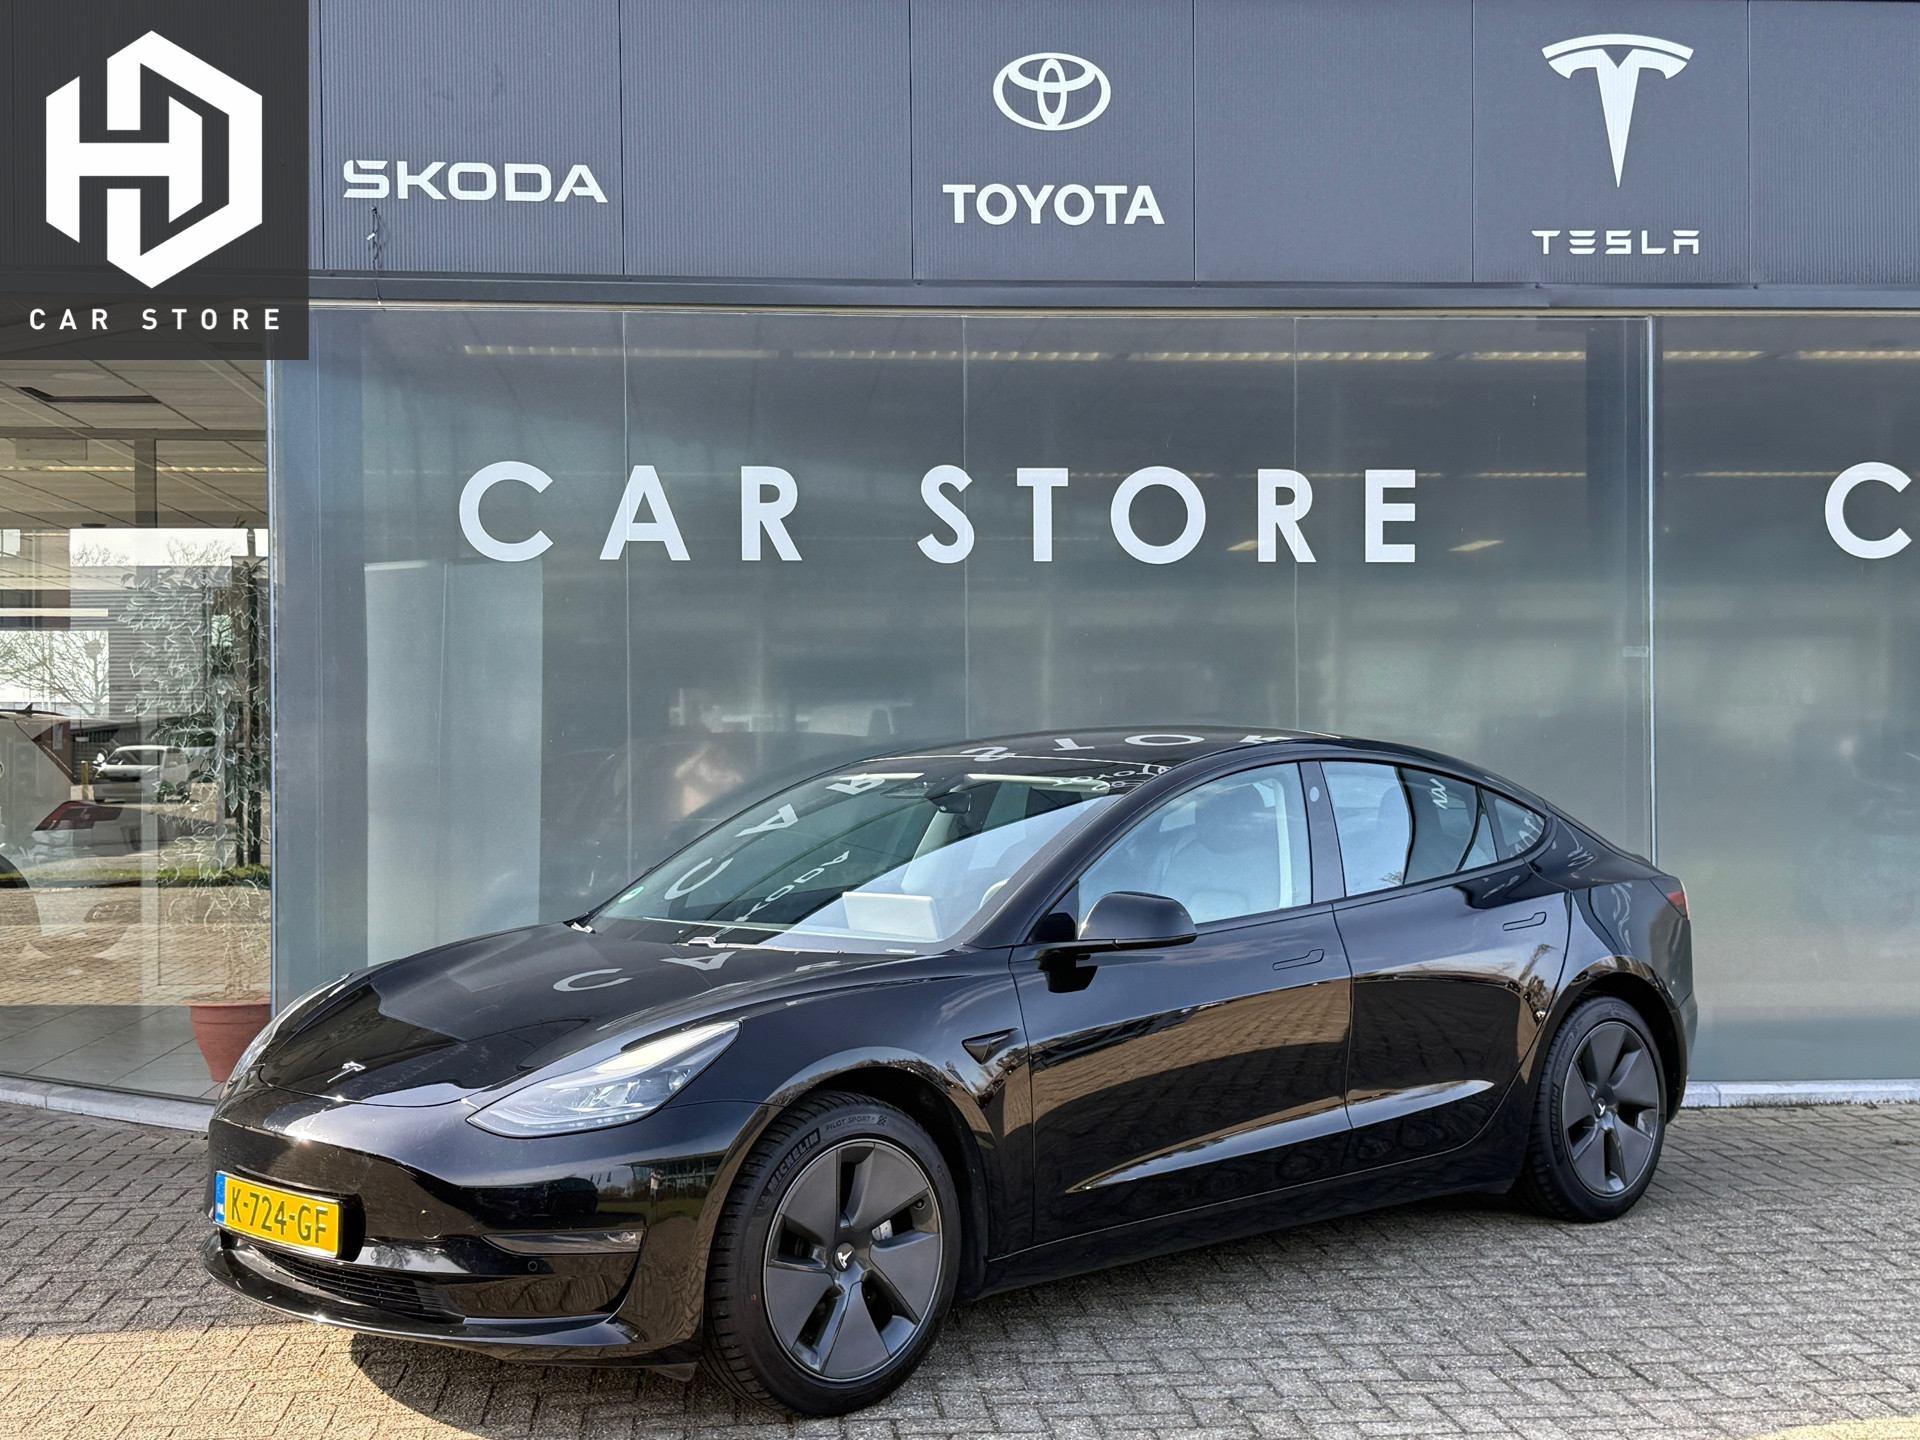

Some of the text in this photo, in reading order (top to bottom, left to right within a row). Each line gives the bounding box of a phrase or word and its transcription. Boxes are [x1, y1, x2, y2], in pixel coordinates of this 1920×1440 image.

[942, 183, 1165, 227] TOYOTA
[1531, 229, 1701, 256] TESLA
[458, 460, 1417, 565] CAR STORE
[1824, 461, 1913, 559] C
[766, 1131, 819, 1194] MICHELIN
[231, 1186, 329, 1244] K-724-GF
